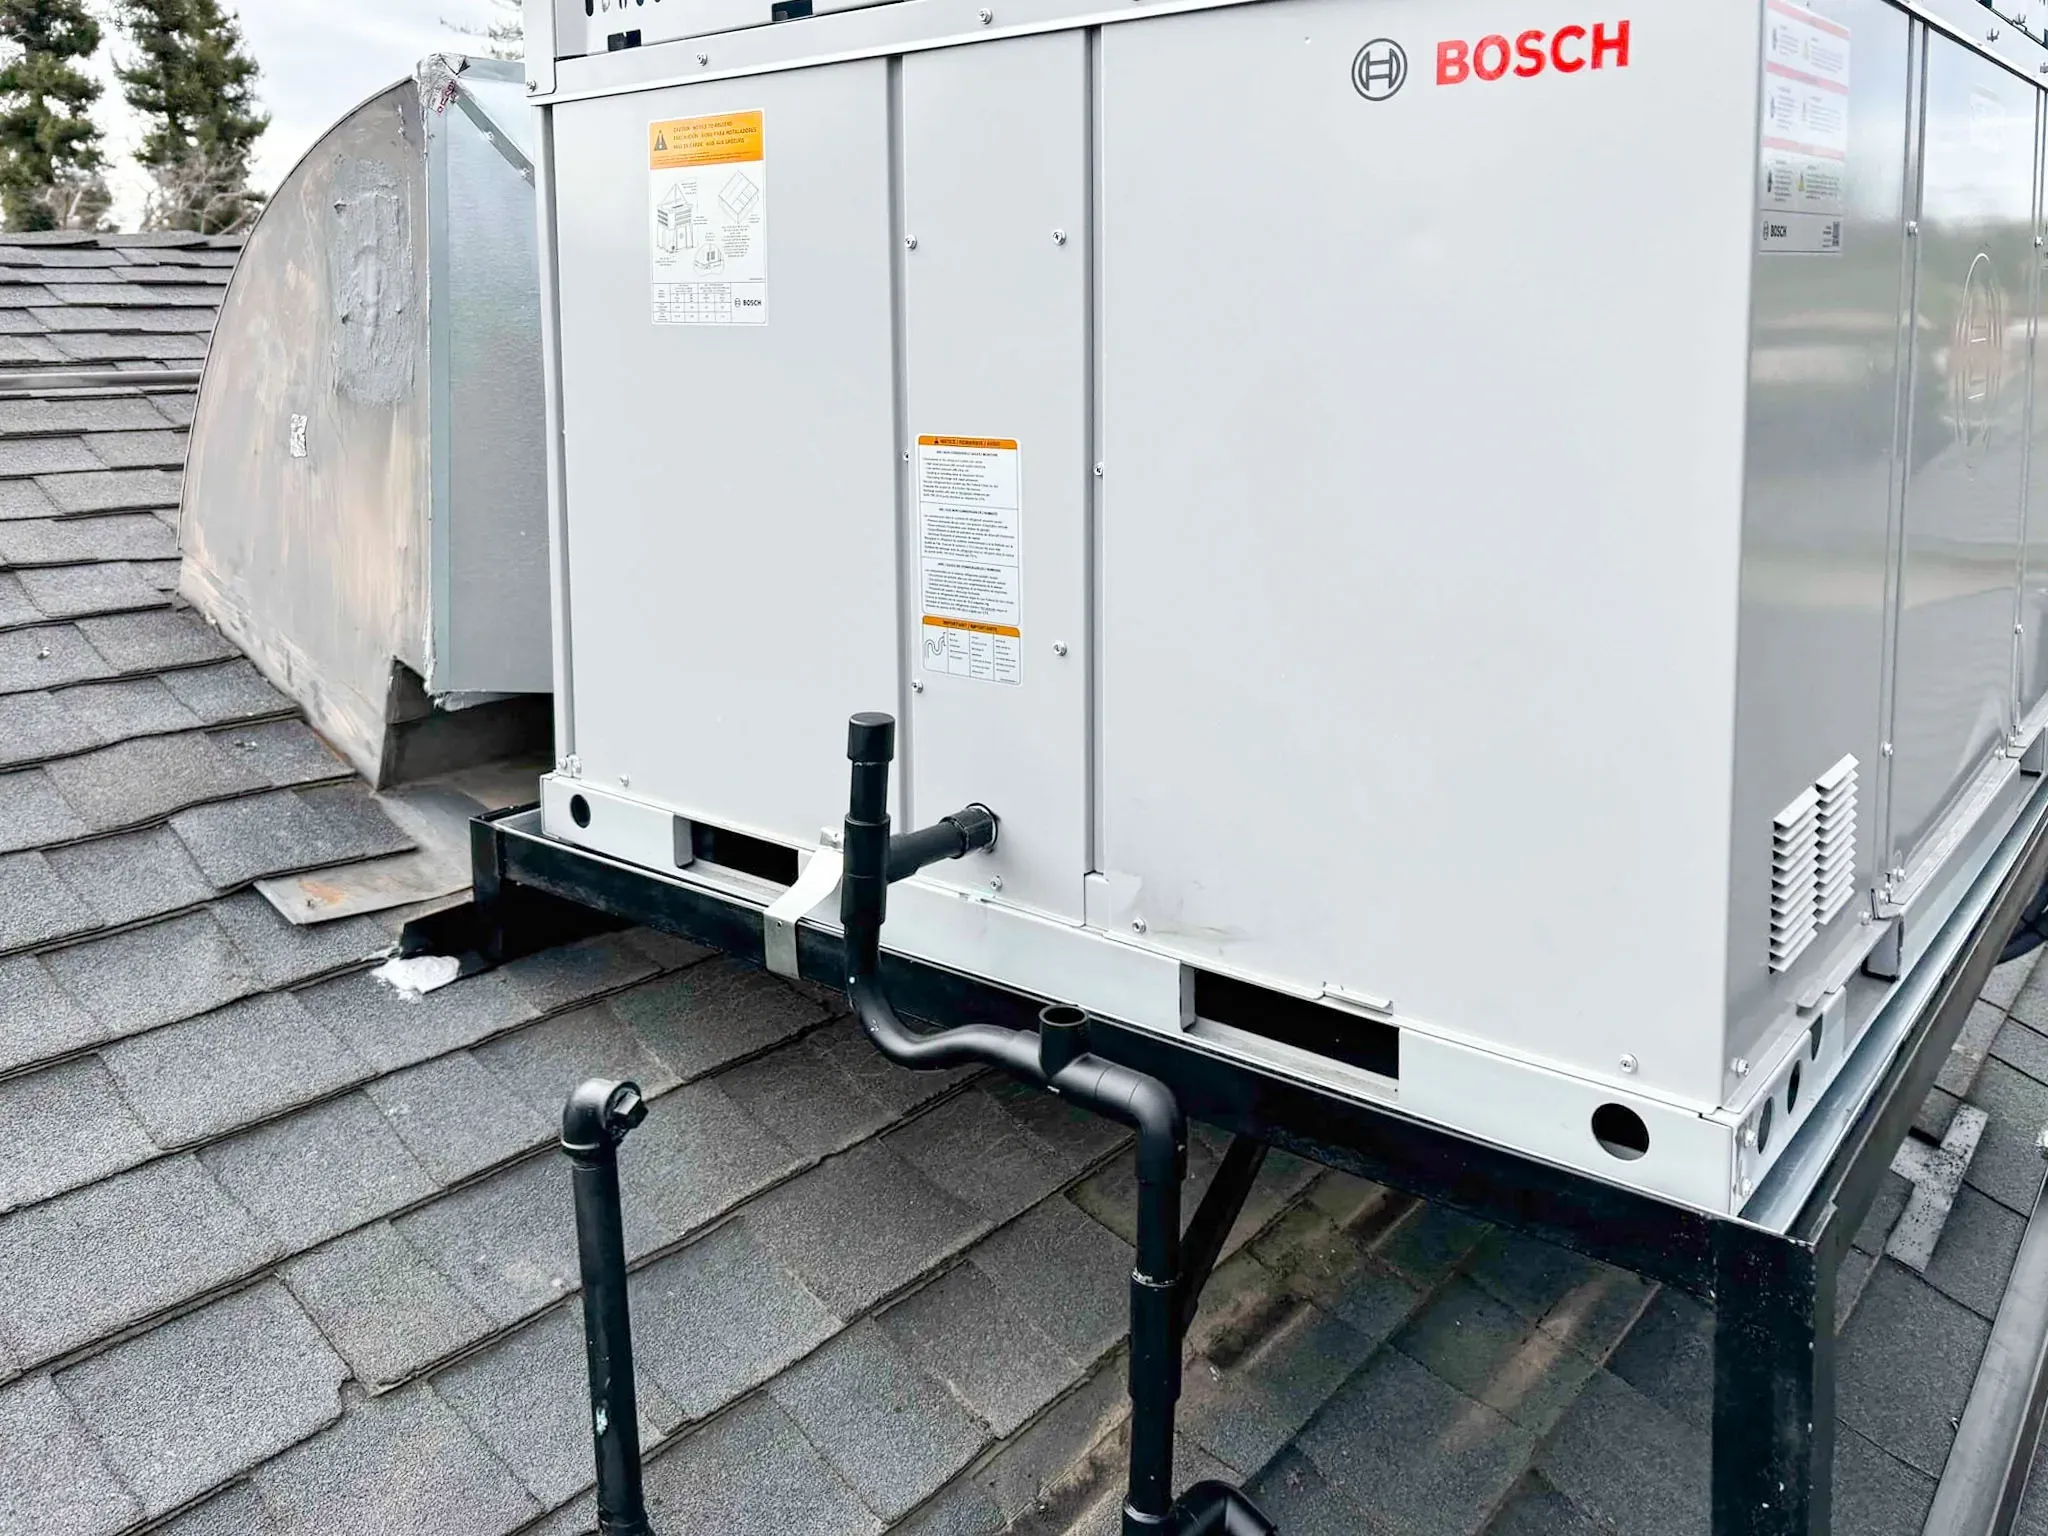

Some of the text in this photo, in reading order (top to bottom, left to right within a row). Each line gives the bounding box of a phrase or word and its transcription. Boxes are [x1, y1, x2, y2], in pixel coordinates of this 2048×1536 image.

[1436, 20, 1630, 85] BOSCH
[1770, 224, 1787, 238] BOSCH
[743, 299, 762, 307] BOSCH
